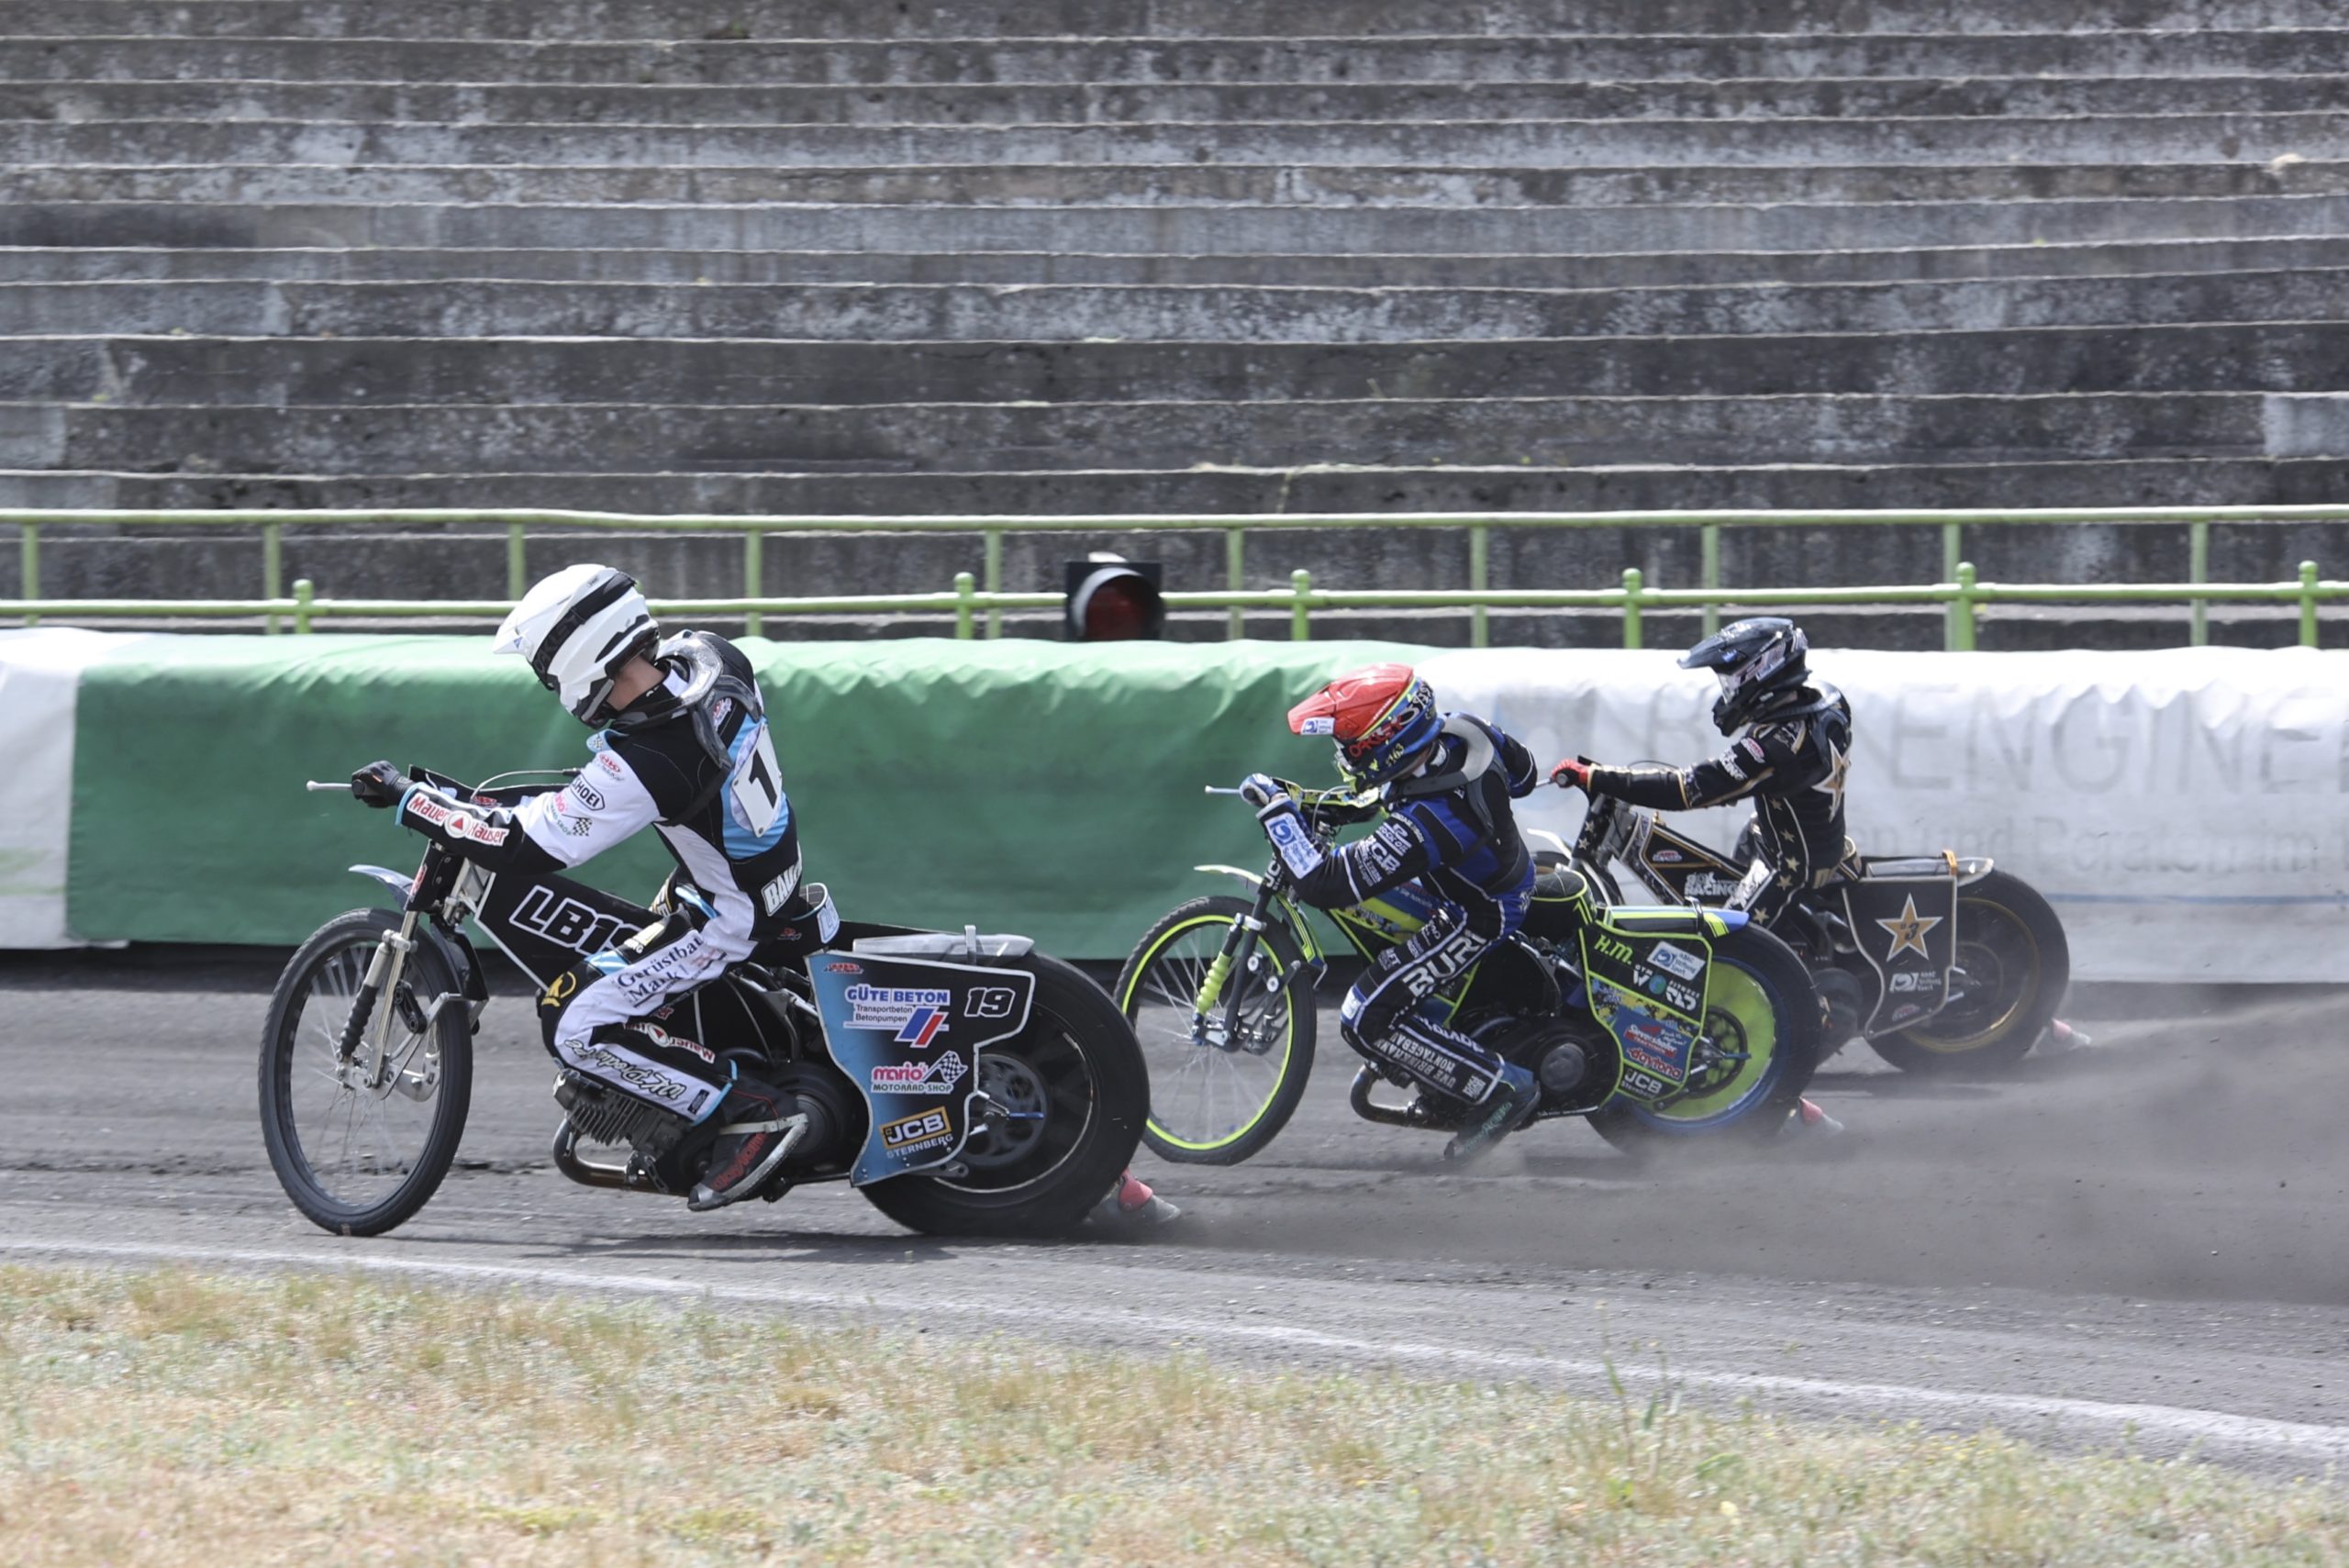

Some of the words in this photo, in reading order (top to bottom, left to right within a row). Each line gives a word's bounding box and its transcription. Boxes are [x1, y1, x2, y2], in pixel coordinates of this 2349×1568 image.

[748, 749, 778, 809] 1
[409, 795, 450, 823] Mauer
[469, 819, 507, 845] Häuser
[847, 984, 889, 1002] GÜTE
[894, 990, 948, 1004] BETON
[964, 987, 1016, 1018] 19
[855, 1004, 913, 1015] Transportbeton
[855, 1013, 907, 1023] Betonpumpen
[1389, 1031, 1457, 1073] MONTAGEBAU
[1433, 1068, 1457, 1089] UWE
[1624, 1068, 1663, 1094] JCB
[886, 1113, 945, 1143] JCB
[885, 1133, 954, 1159] STERNBERG
